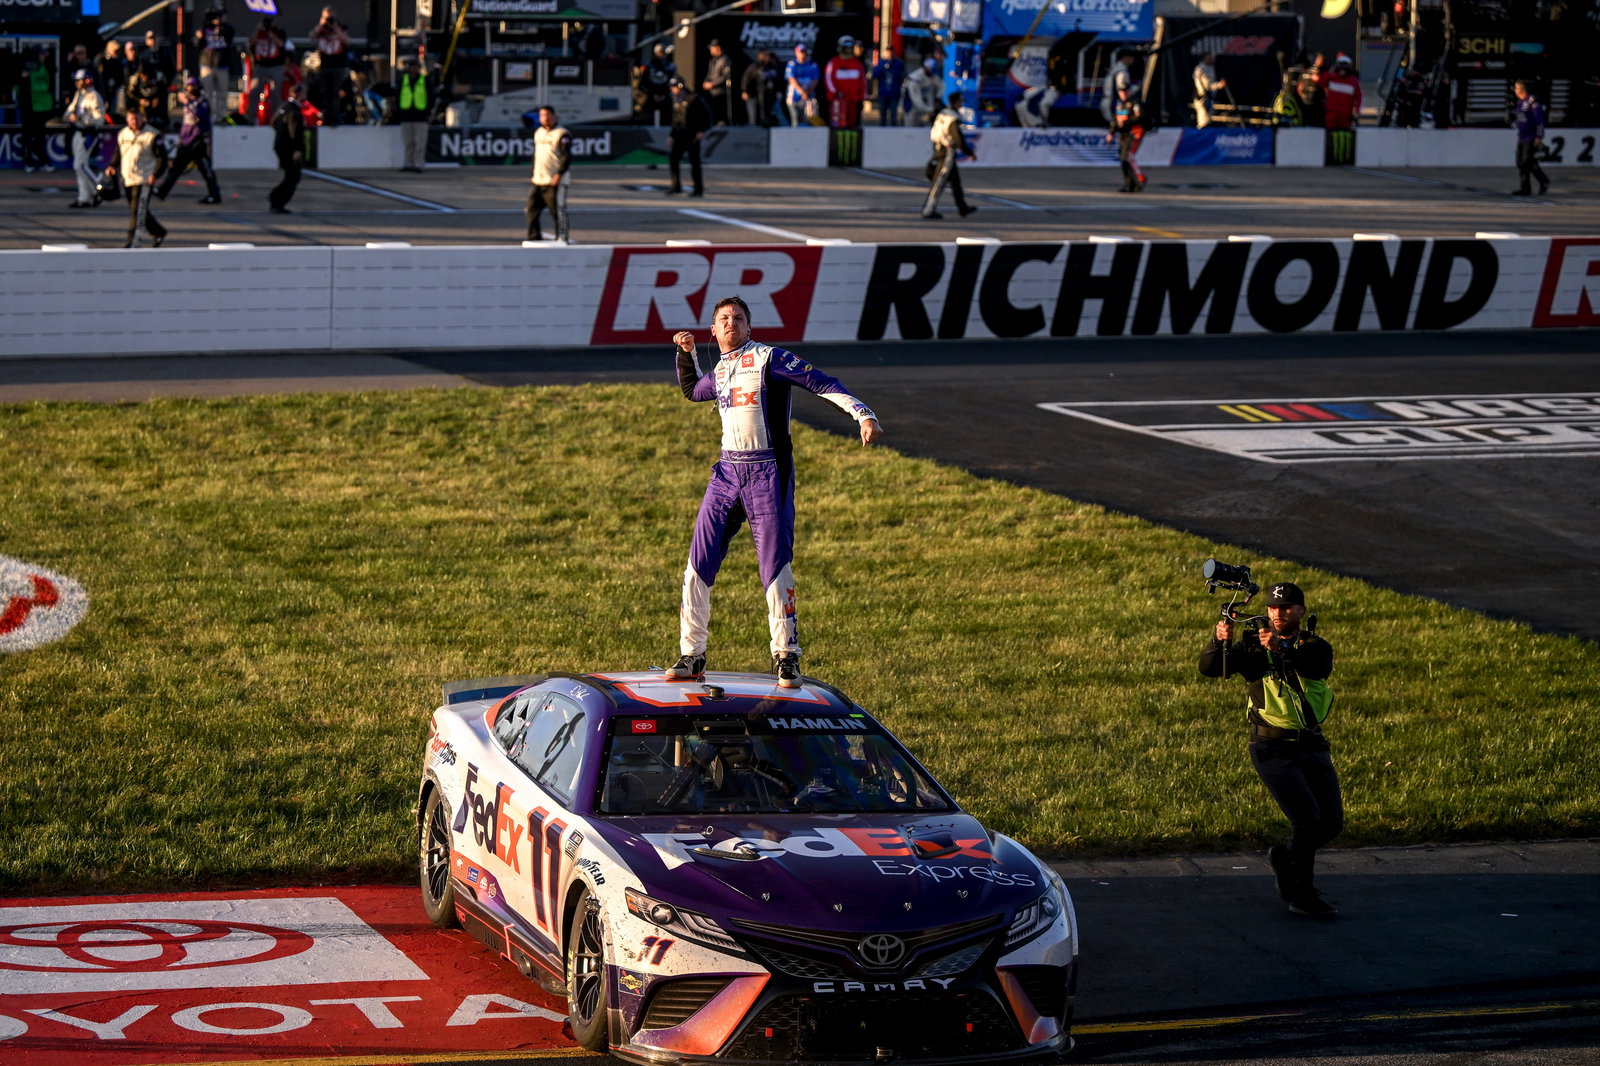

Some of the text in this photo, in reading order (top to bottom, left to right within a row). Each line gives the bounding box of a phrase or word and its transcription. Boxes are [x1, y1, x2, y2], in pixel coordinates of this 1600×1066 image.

[1459, 37, 1506, 55] 3CHI
[440, 132, 612, 157] Nationsard
[612, 239, 1500, 341] RR RICHMOND
[1373, 398, 1600, 420] NAS
[768, 716, 868, 731] HAMLIN
[452, 761, 570, 945] FedEx 11
[640, 827, 1004, 871] FedEx
[574, 857, 606, 886] GOODYEAR
[871, 859, 1037, 888] Express
[636, 935, 676, 967] 11
[812, 977, 957, 994] CAMRY
[0, 993, 569, 1041] YOTA
